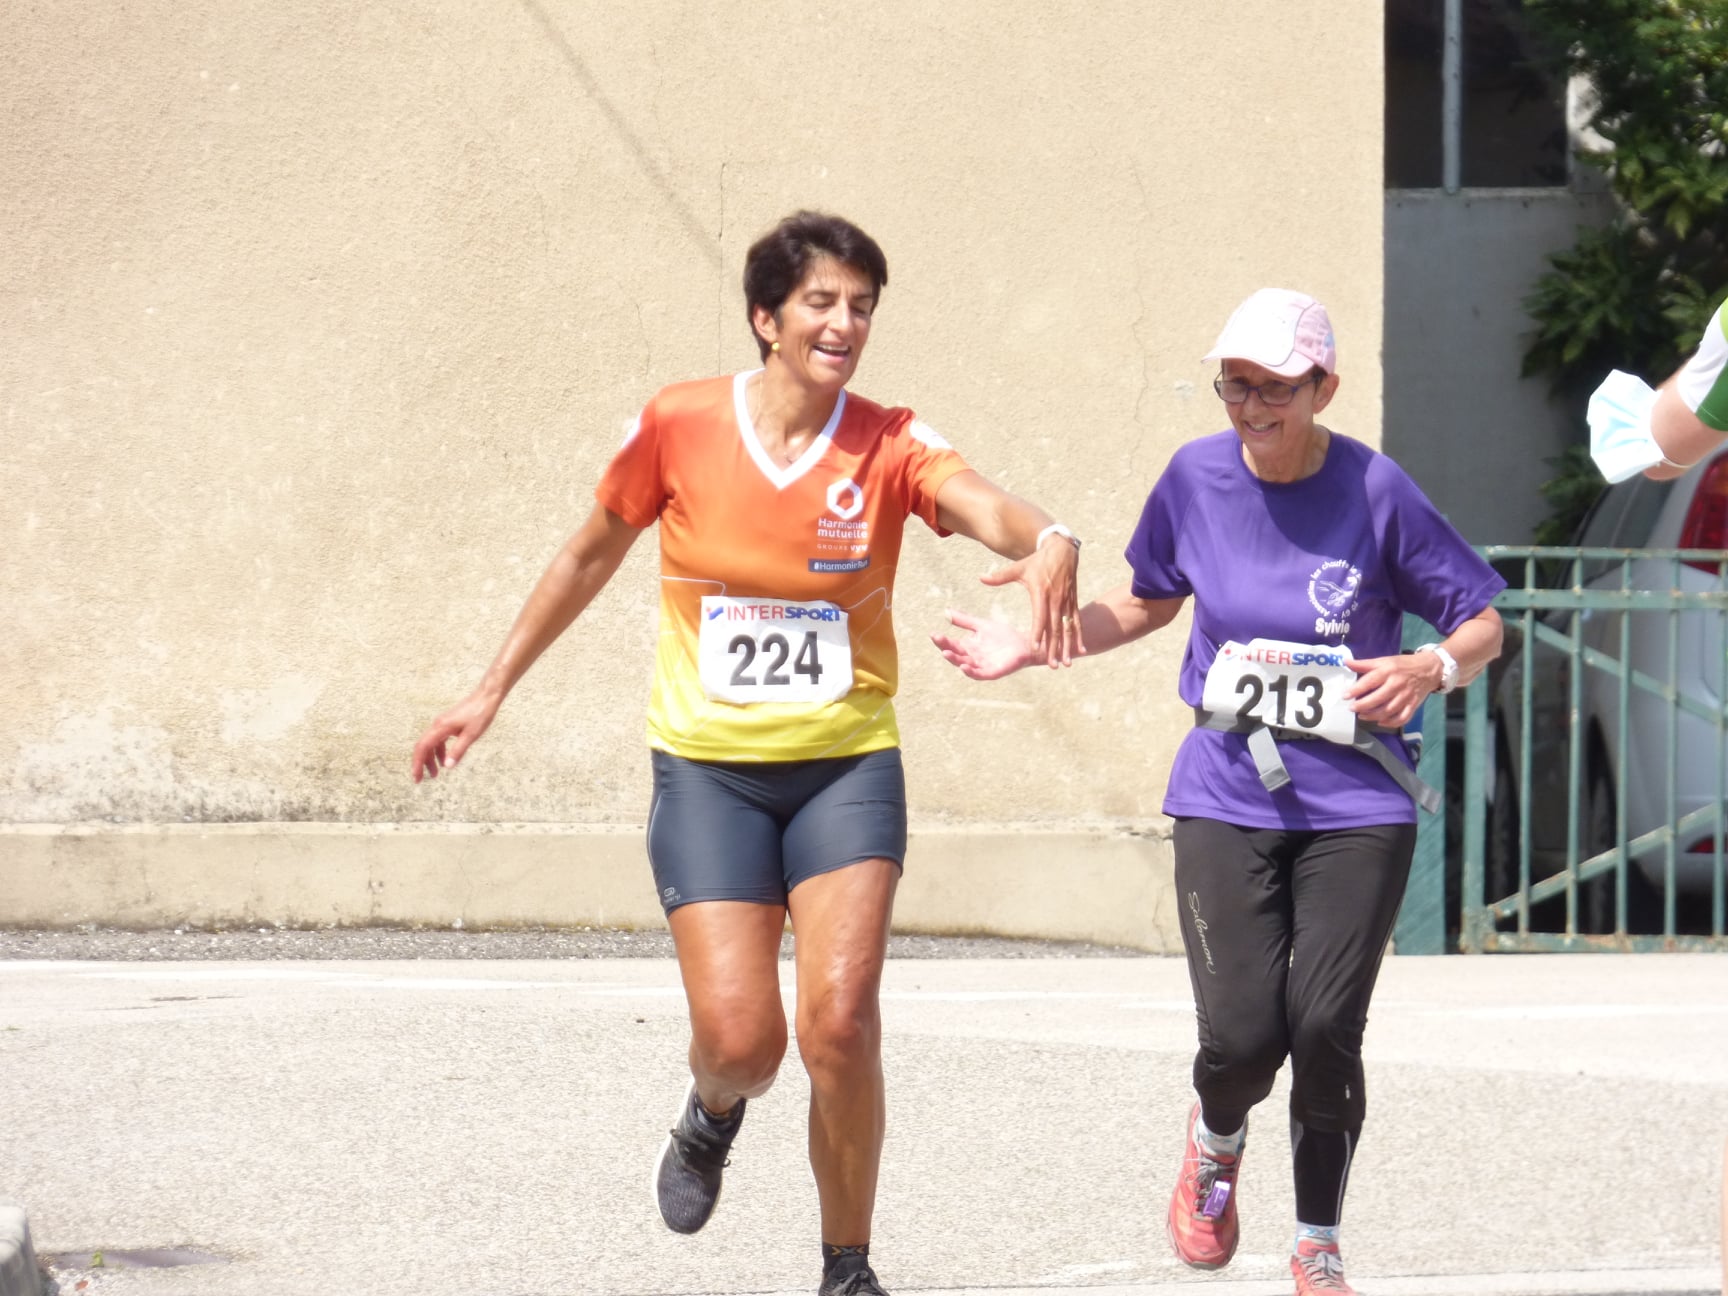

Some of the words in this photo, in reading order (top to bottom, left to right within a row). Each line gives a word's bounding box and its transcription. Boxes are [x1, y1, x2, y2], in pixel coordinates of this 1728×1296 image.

[818, 518, 868, 529] Harmonie
[817, 528, 868, 538] mutuelle
[727, 605, 841, 622] INTERSPORT
[1315, 617, 1351, 637] Sylvie
[727, 630, 823, 686] 224
[1235, 673, 1324, 729] 213
